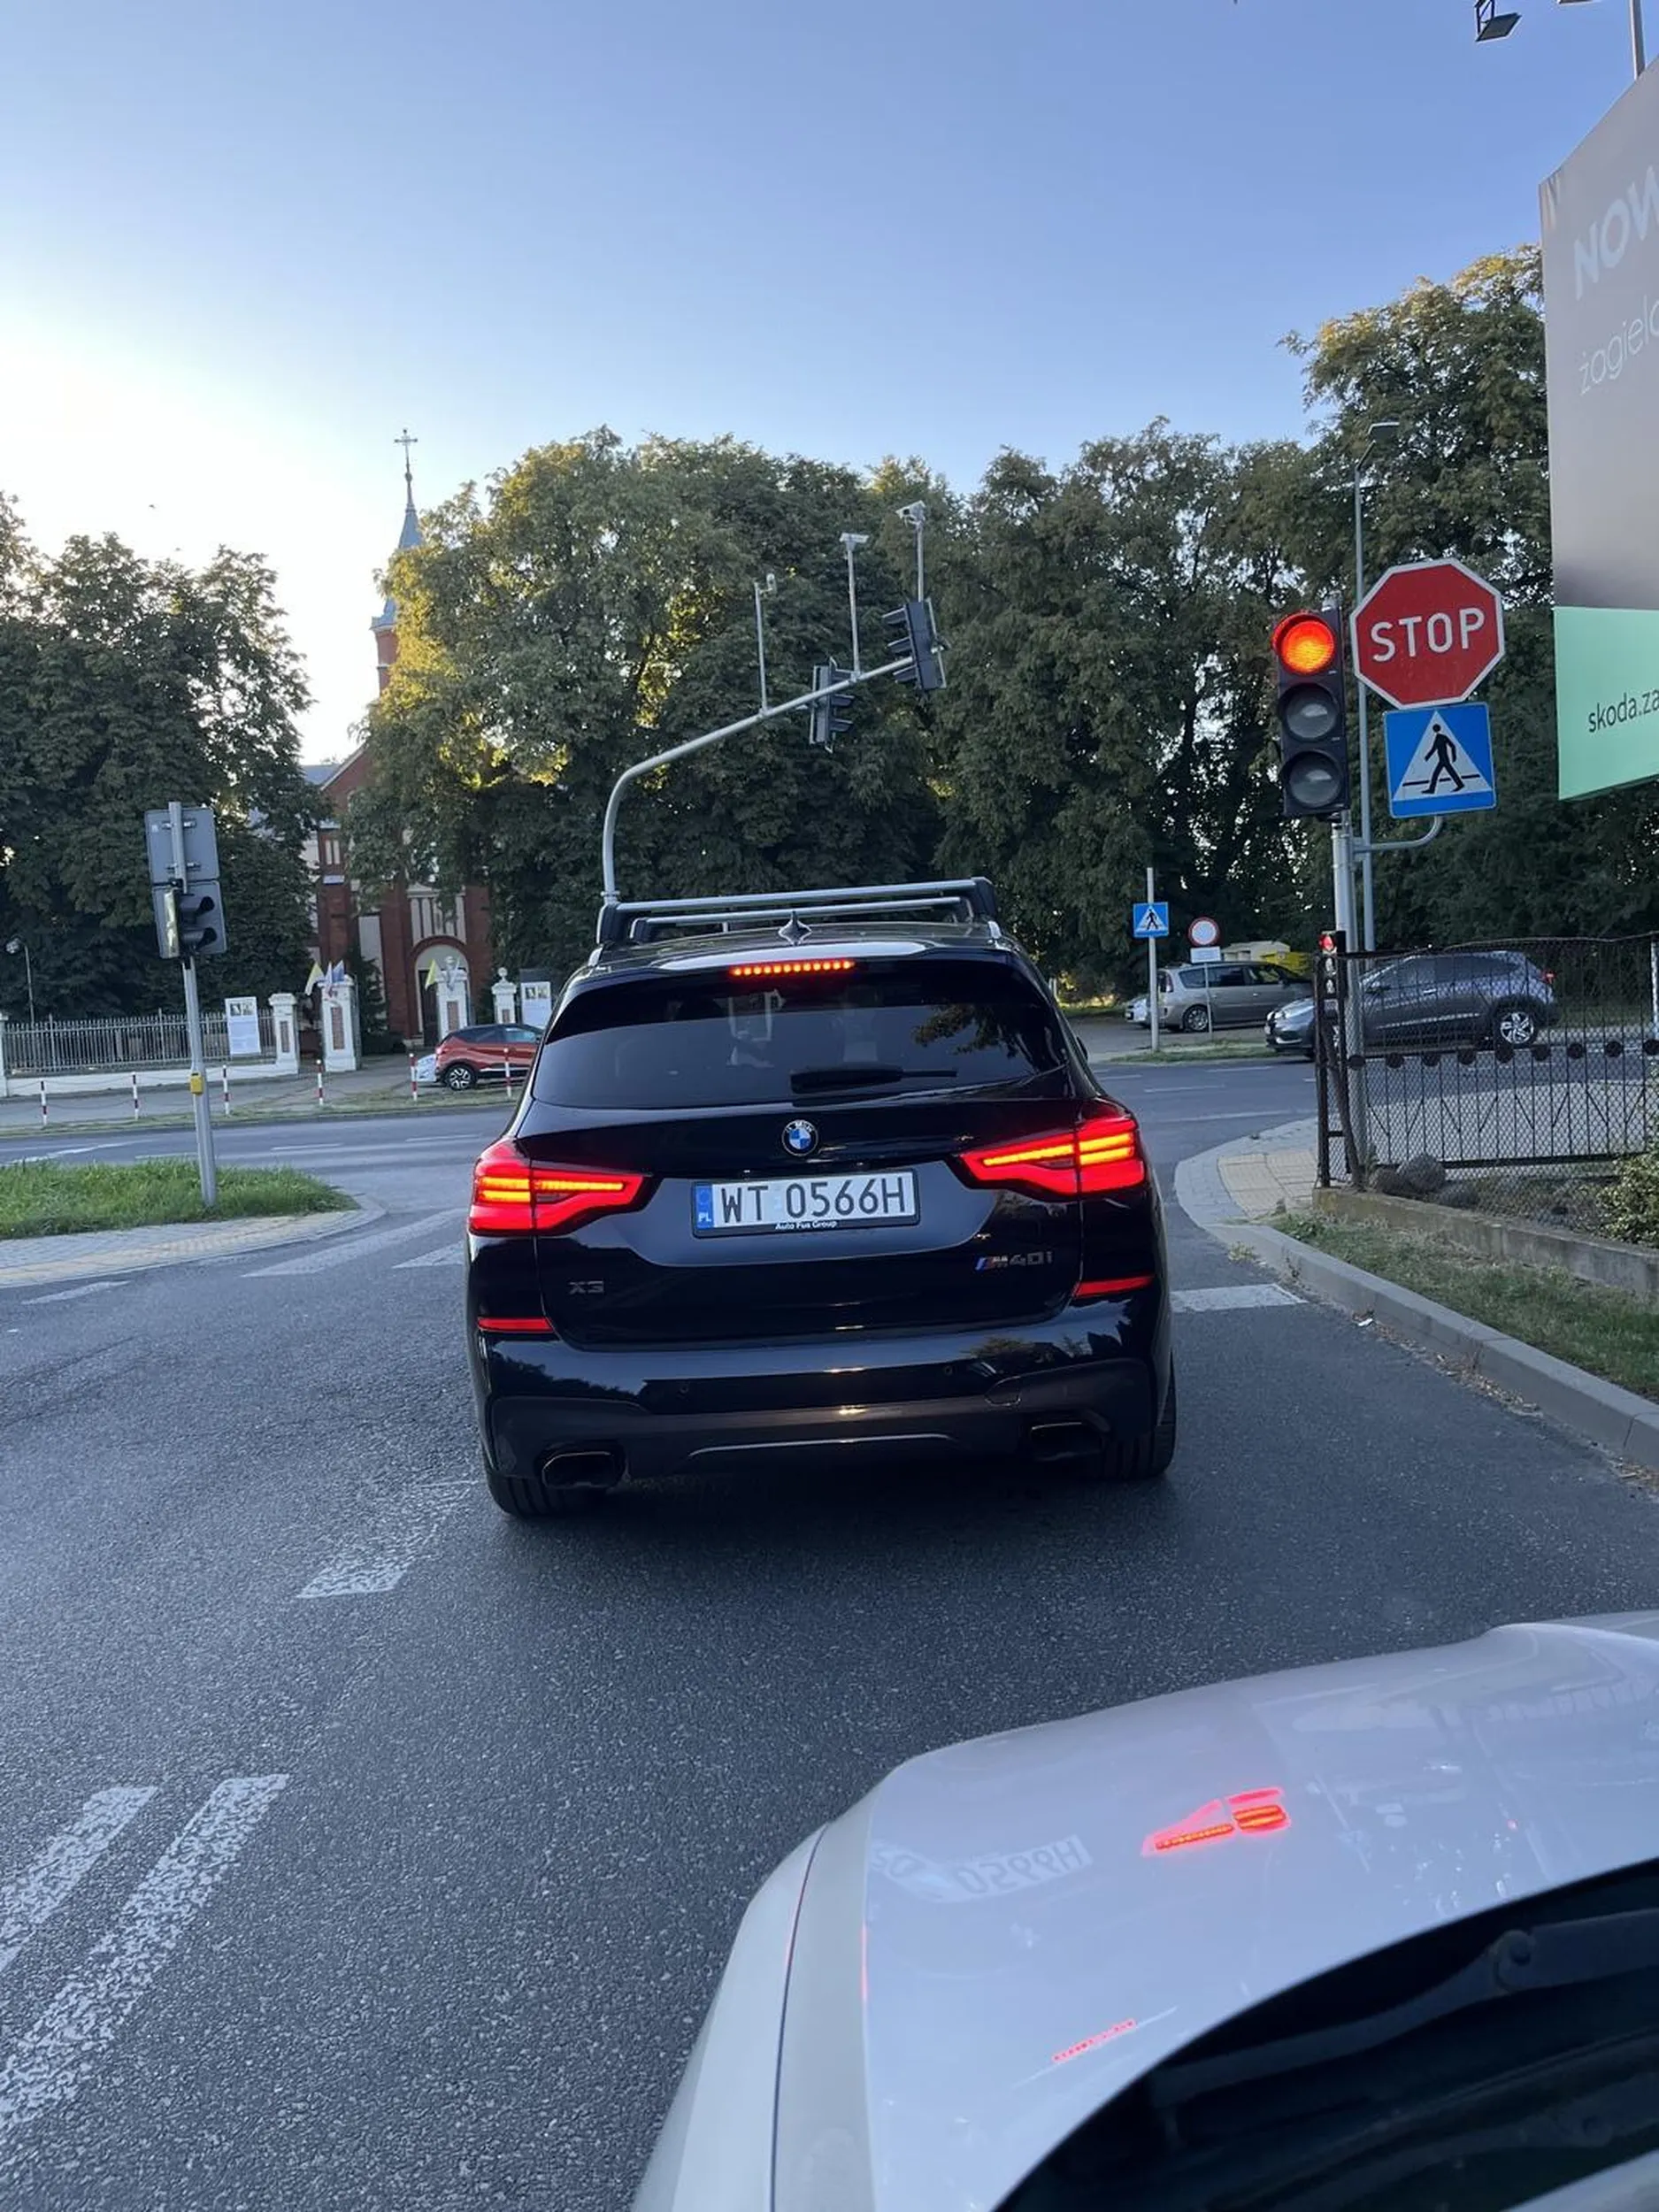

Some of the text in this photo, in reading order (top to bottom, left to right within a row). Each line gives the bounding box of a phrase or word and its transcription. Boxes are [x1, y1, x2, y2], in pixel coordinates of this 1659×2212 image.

[1371, 607, 1486, 662] STOP
[1588, 689, 1659, 733] skoda.za
[698, 1212, 712, 1222] PL
[721, 1177, 906, 1223] WT 0566H
[569, 1280, 604, 1295] X3
